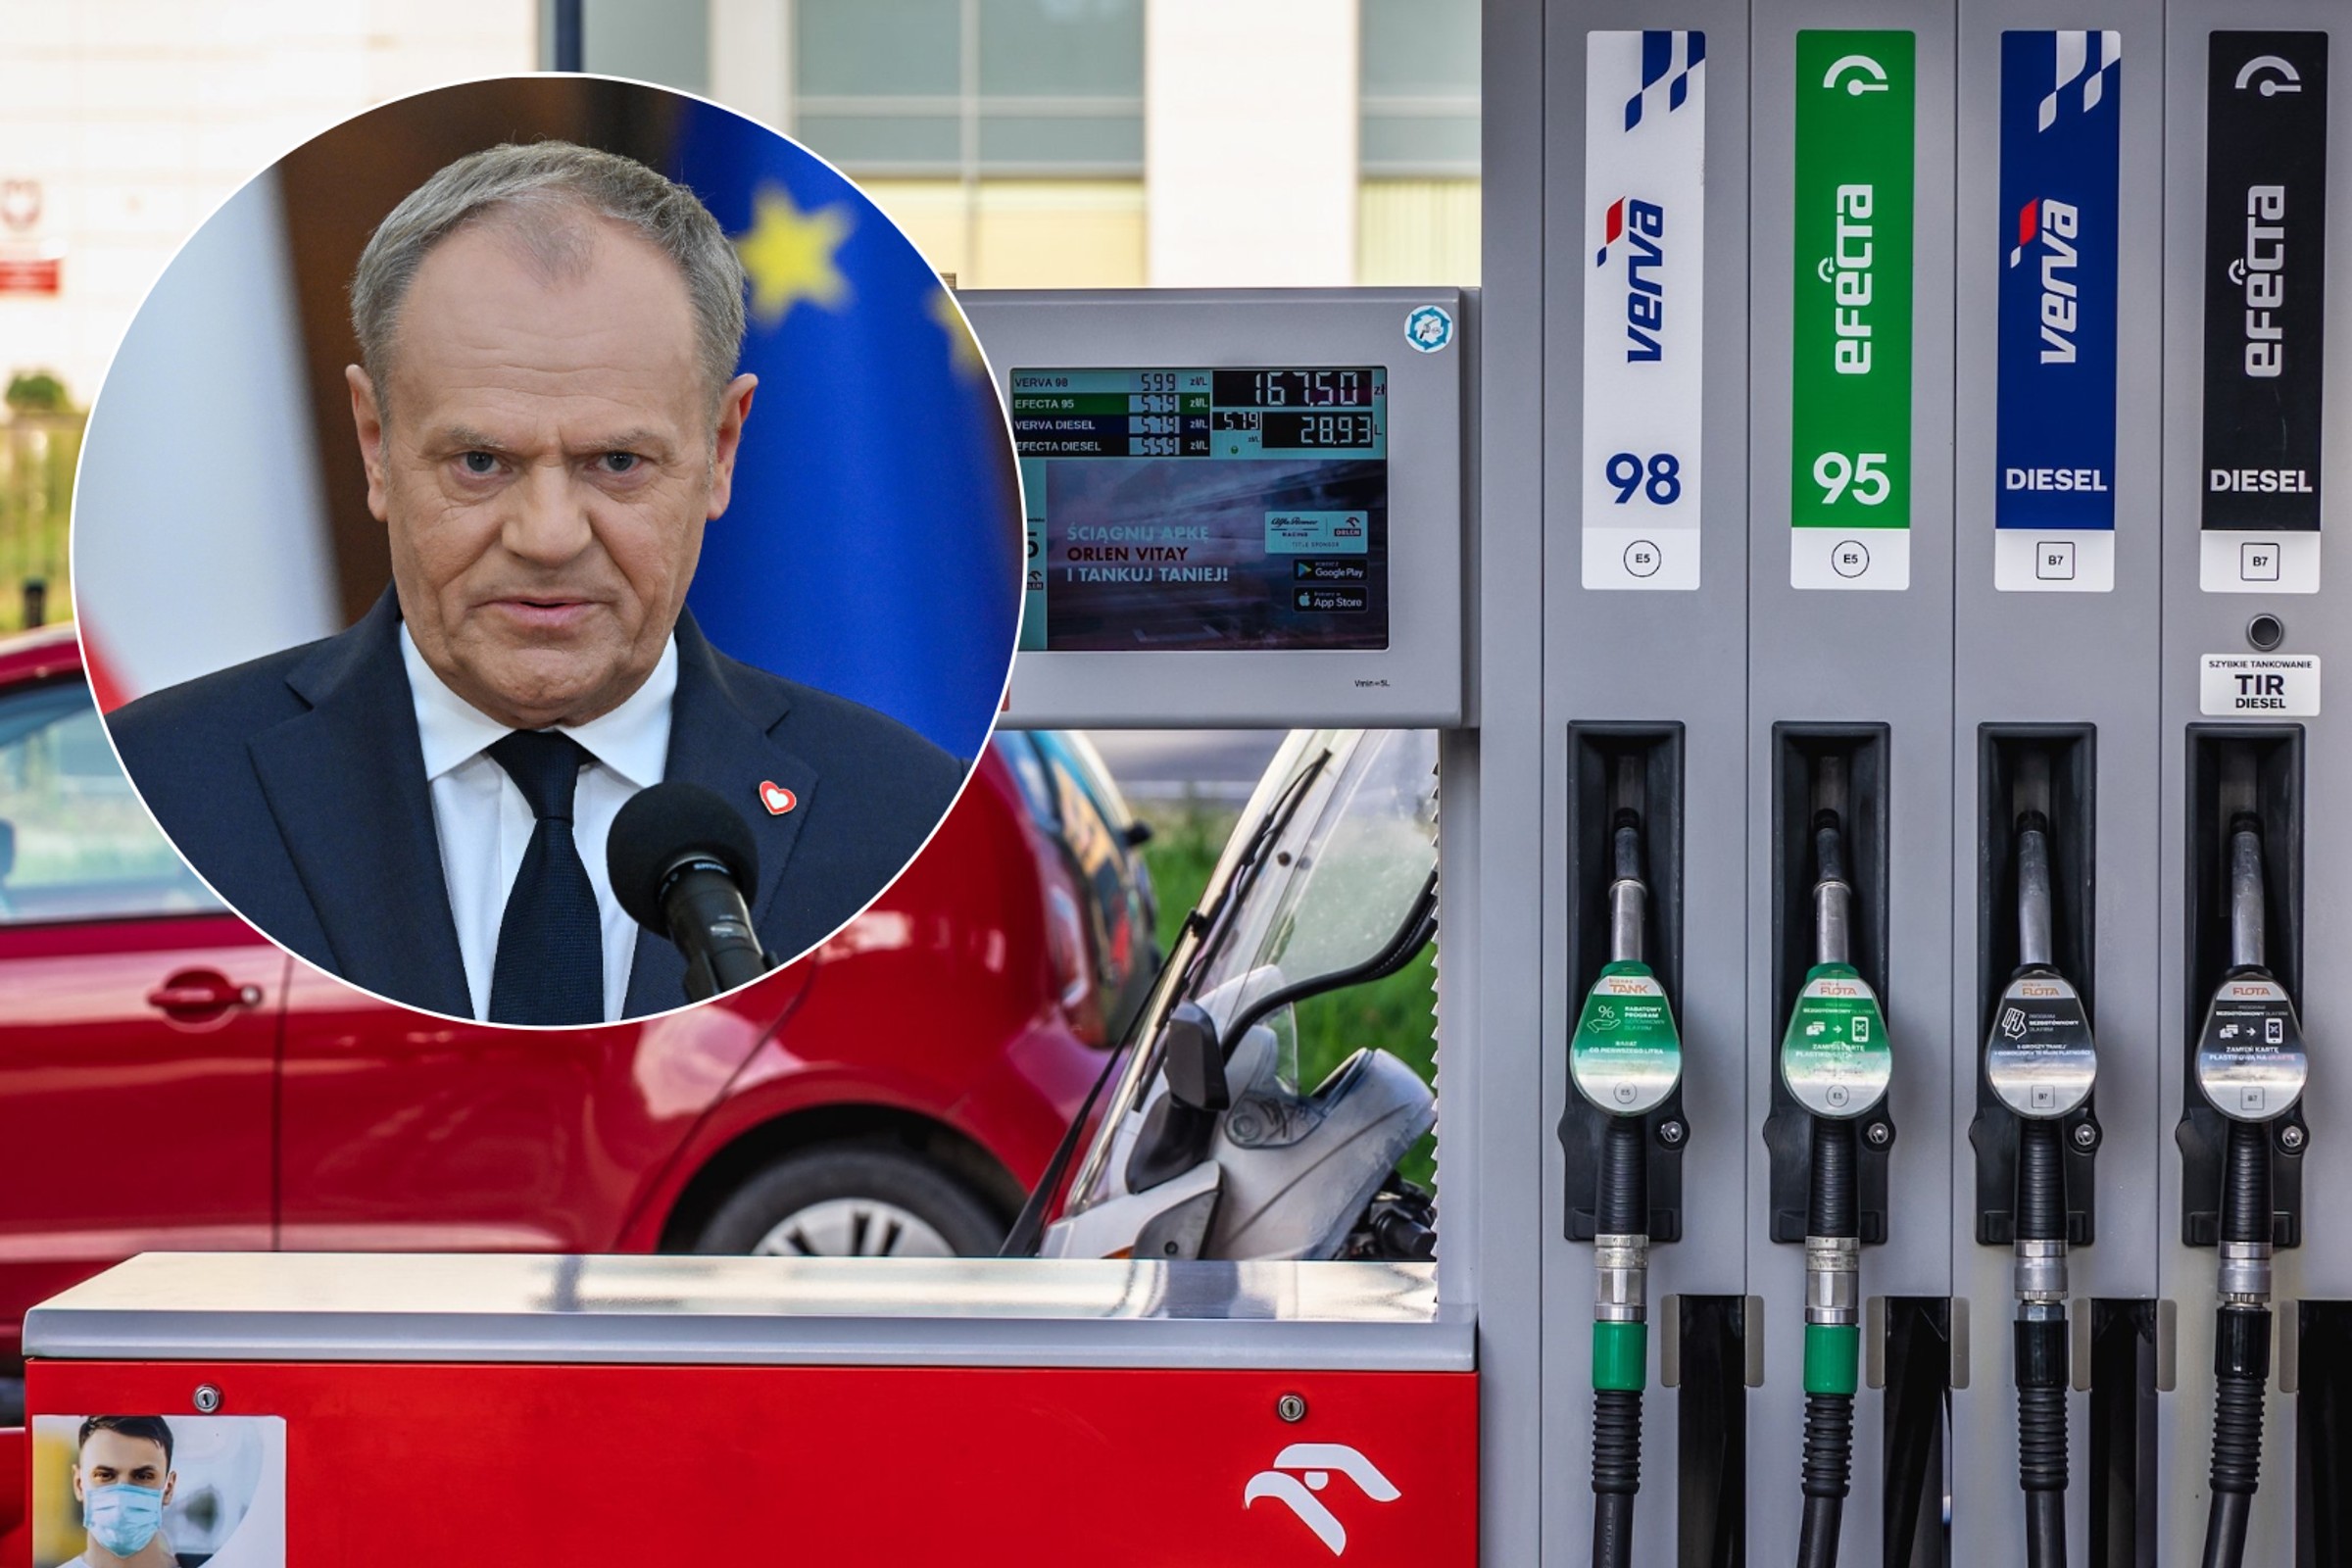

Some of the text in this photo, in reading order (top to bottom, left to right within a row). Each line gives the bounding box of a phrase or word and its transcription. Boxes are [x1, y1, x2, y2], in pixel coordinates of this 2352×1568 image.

[1628, 199, 1663, 364] verva
[1836, 184, 1873, 374] efecta
[2040, 199, 2078, 365] verva
[2245, 185, 2284, 377] efecta
[1015, 377, 1068, 387] VERVA 98
[1374, 383, 1385, 396] zł
[1014, 399, 1074, 410] EFECTA 95
[1015, 420, 1096, 430] VERVA DIESEL
[1375, 424, 1383, 435] L
[1016, 442, 1102, 452] EFECTA DIESEL
[1606, 453, 1682, 506] 98
[1813, 452, 1891, 506] 95
[2006, 468, 2108, 491] DIESEL
[2210, 469, 2313, 493] DIESEL
[1067, 521, 1209, 544] ŚCIĄGNIJ APKĘ
[1067, 547, 1189, 562] ORLEN VITAY
[1636, 553, 1650, 564] E5
[1843, 554, 1858, 564] E5
[2048, 555, 2064, 565] B7
[2252, 556, 2269, 566] B7
[1067, 568, 1229, 582] I TANKUJ TANIEJ!
[1315, 567, 1363, 578] Google Play
[1314, 598, 1362, 609] App Store
[2234, 674, 2284, 695] TIR
[2235, 698, 2286, 709] DIESEL
[1609, 984, 1648, 993] TANK
[1820, 987, 1857, 996] FLOTA
